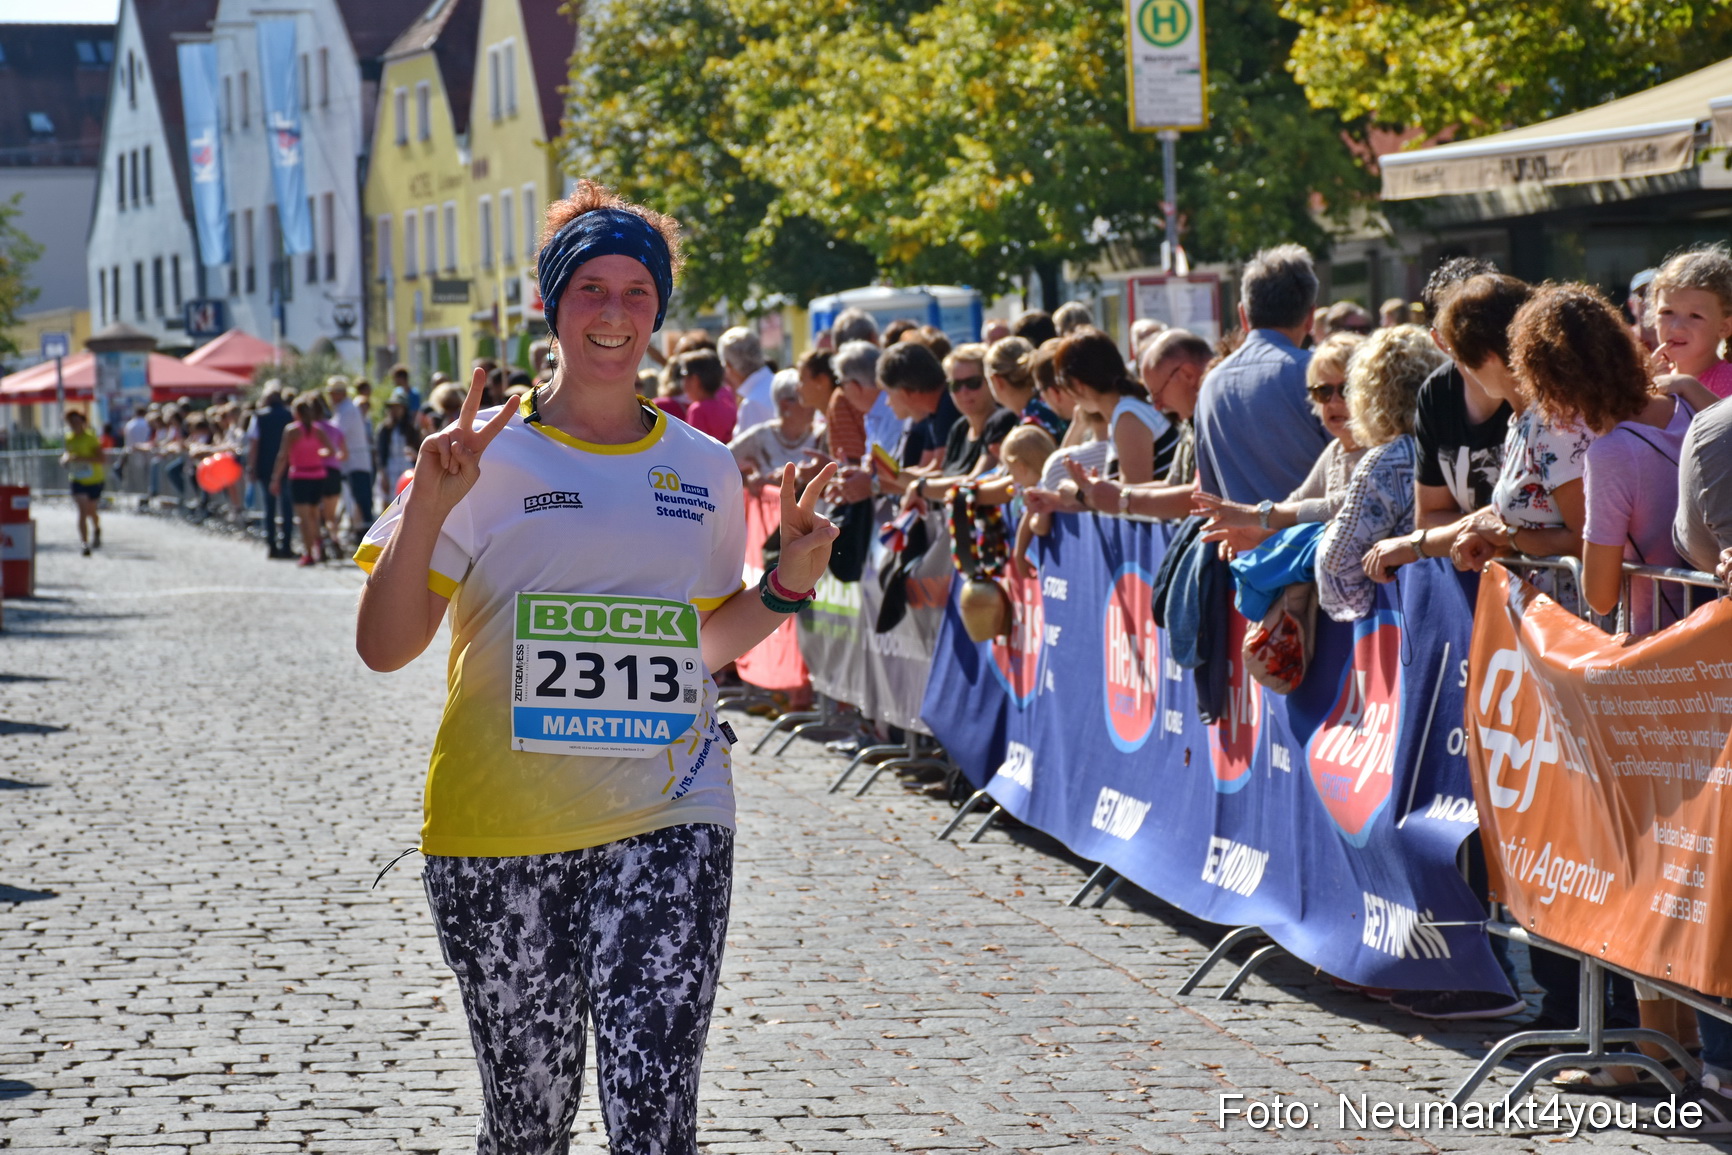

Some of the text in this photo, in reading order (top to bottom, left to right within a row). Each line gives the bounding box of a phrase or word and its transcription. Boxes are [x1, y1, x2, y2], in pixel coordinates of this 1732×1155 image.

[651, 471, 680, 492] 20
[683, 485, 708, 496] JAHRE
[524, 491, 583, 510] BOCK
[654, 491, 716, 513] Neumarkter
[656, 505, 704, 526] Stadtlauf
[529, 600, 688, 642] BOCK
[536, 650, 680, 702] 2313
[685, 661, 694, 670] D
[1584, 662, 1638, 685] Neumarkts
[1635, 662, 1698, 685] moderner
[1615, 695, 1683, 722] Konzeption
[1678, 691, 1706, 714] und
[543, 715, 671, 740] MARTINA
[1609, 724, 1640, 746] Ihrer
[1637, 725, 1690, 753] Projekte
[1689, 729, 1711, 748] was
